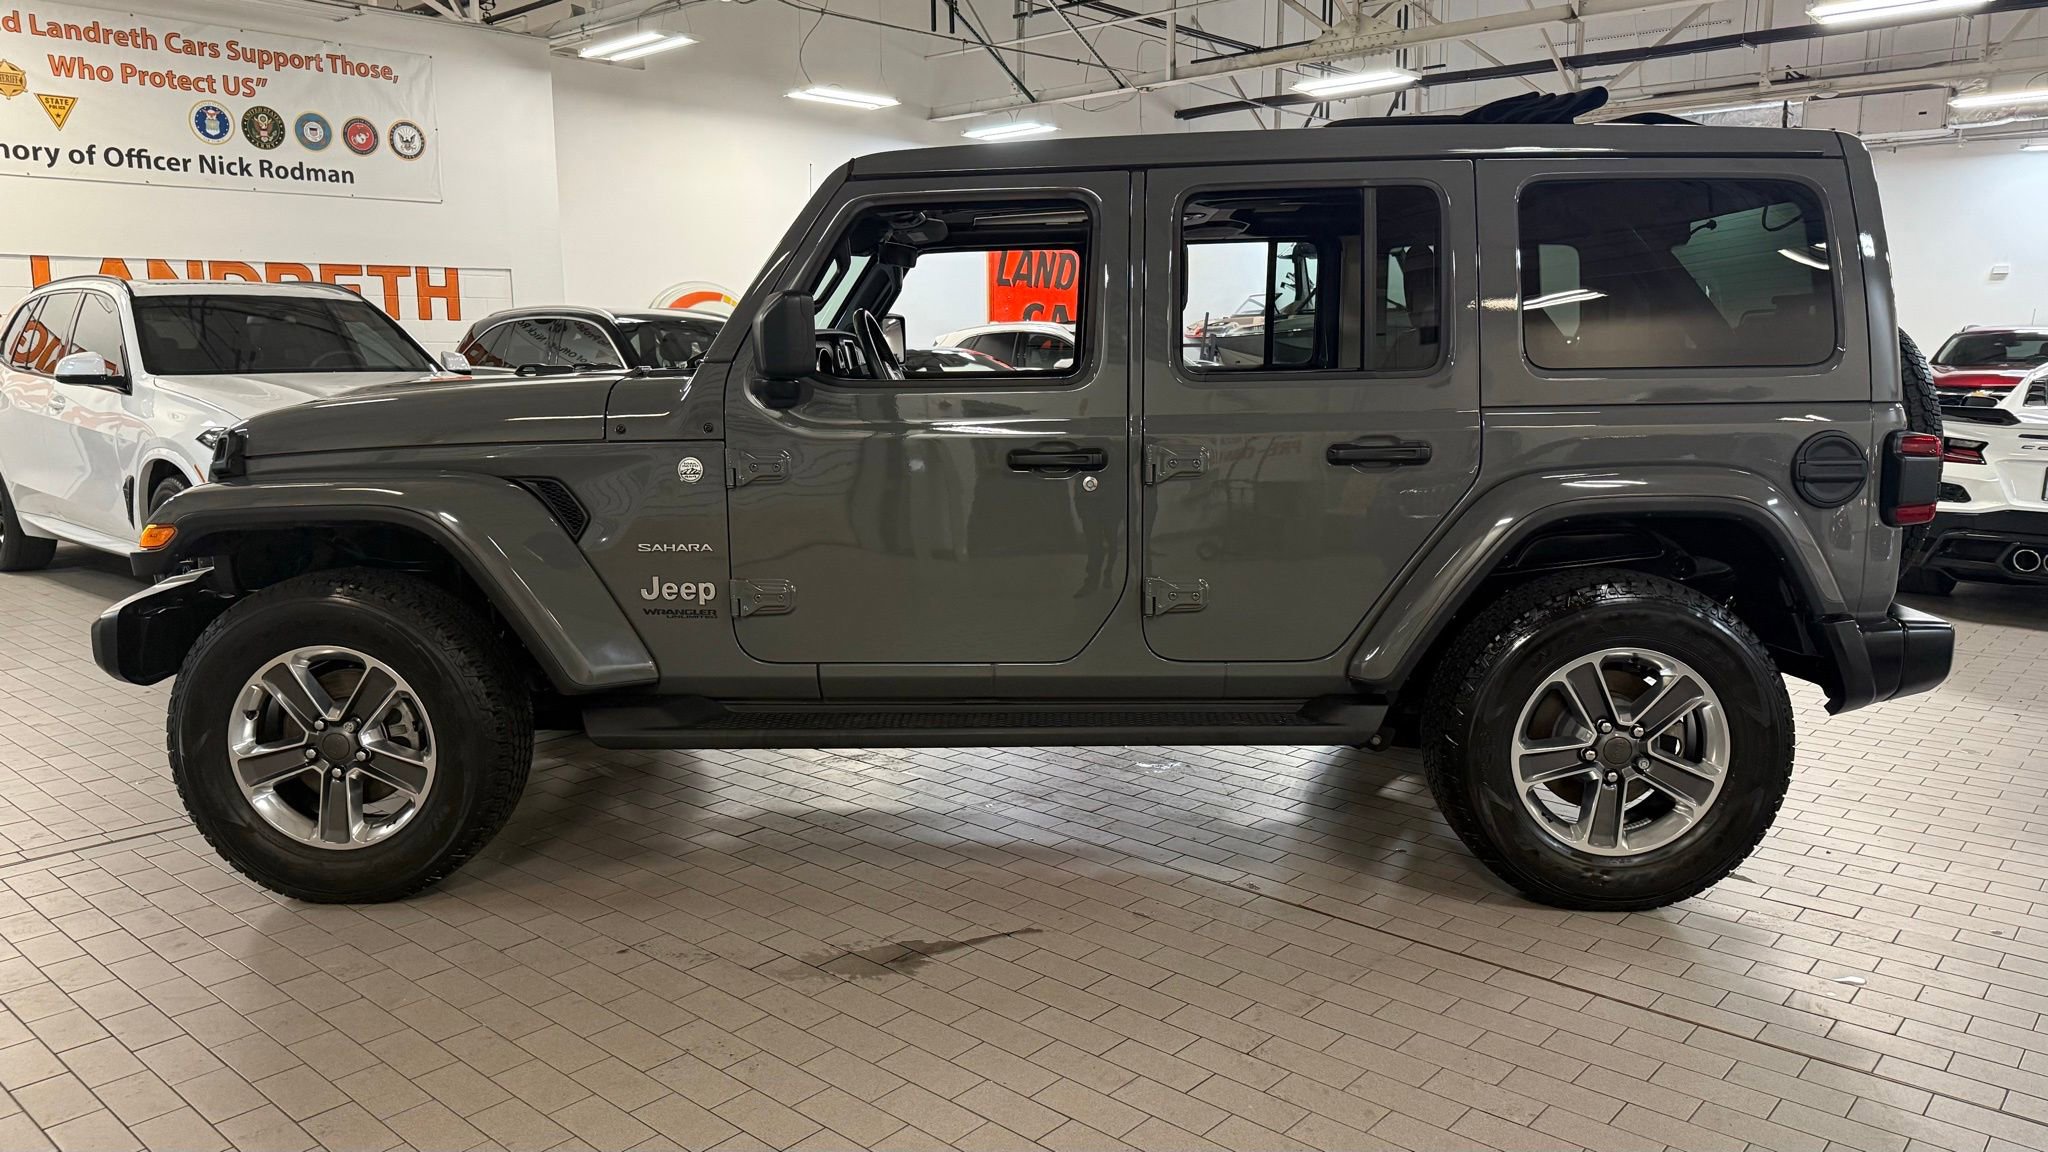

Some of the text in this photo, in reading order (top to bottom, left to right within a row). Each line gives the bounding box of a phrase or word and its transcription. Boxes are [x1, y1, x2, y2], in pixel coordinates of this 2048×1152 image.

[0, 10, 399, 85] d Landreth Cars Support Those,
[0, 74, 19, 85] ERIFF
[47, 54, 114, 83] Who
[120, 62, 217, 94] Protect
[44, 97, 69, 105] STATE
[68, 144, 96, 165] of
[103, 147, 191, 172] Officer
[198, 154, 253, 178] Nick
[259, 159, 355, 184] Rodman
[637, 543, 713, 552] SAHARA
[641, 576, 716, 605] Jeep
